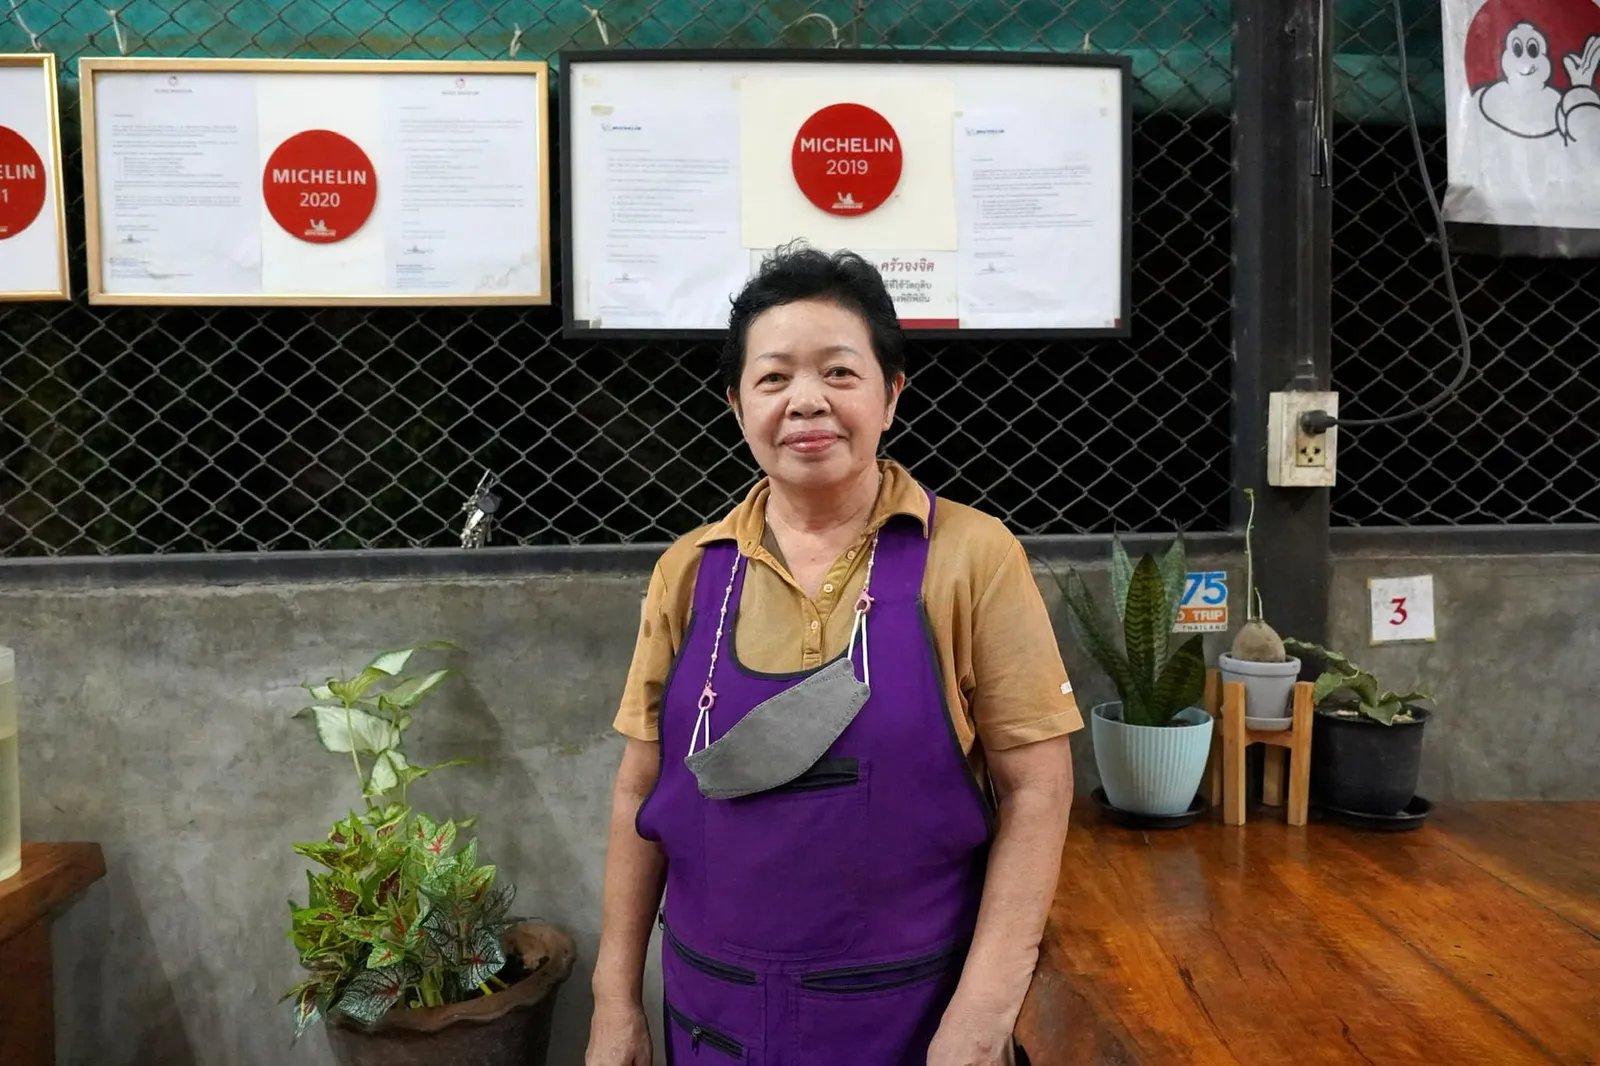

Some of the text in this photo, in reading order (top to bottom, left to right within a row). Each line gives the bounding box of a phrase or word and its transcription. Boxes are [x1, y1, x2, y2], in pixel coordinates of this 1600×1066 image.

[800, 137, 894, 153] MICHELIN
[826, 159, 869, 175] 2019
[272, 168, 367, 185] MICHELIN
[299, 192, 341, 208] 2020
[1180, 572, 1228, 605] 75
[1191, 609, 1224, 622] TRIP
[1388, 596, 1408, 626] 3
